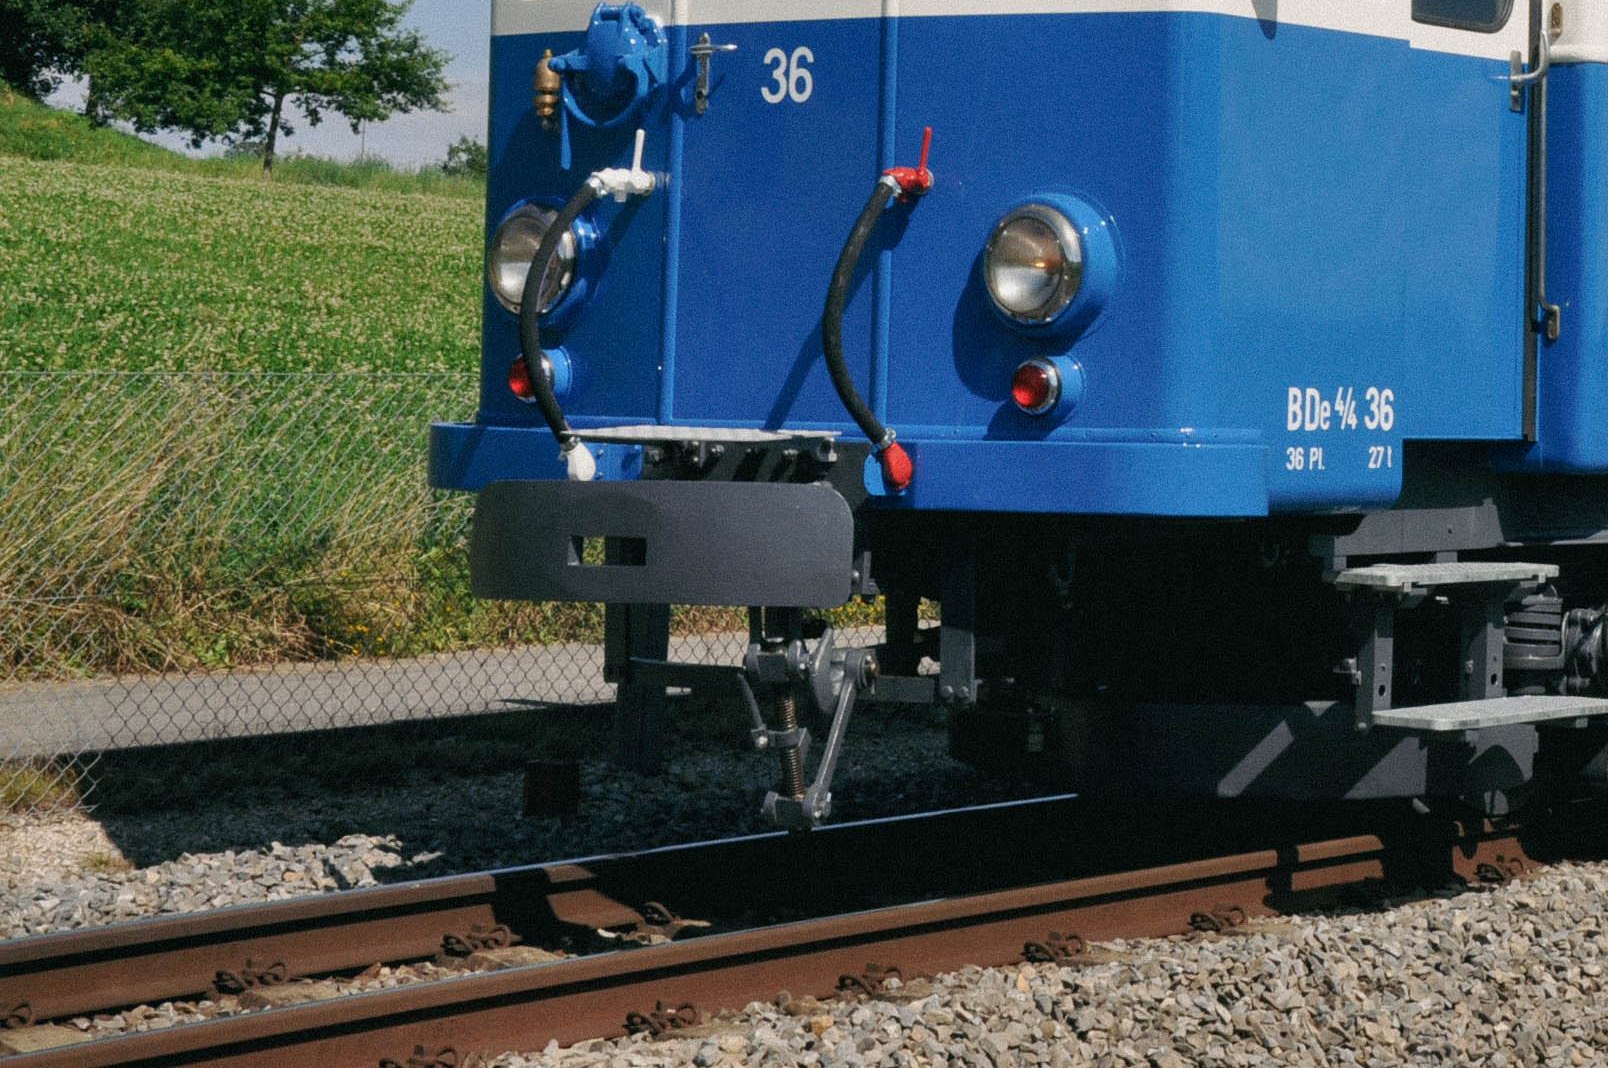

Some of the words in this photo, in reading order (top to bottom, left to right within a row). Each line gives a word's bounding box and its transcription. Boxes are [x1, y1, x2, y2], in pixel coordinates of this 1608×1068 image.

[761, 46, 814, 104] 36
[1287, 386, 1331, 431] BDe
[1364, 386, 1394, 431] 36
[1285, 446, 1304, 470] 36
[1368, 445, 1384, 469] 27
